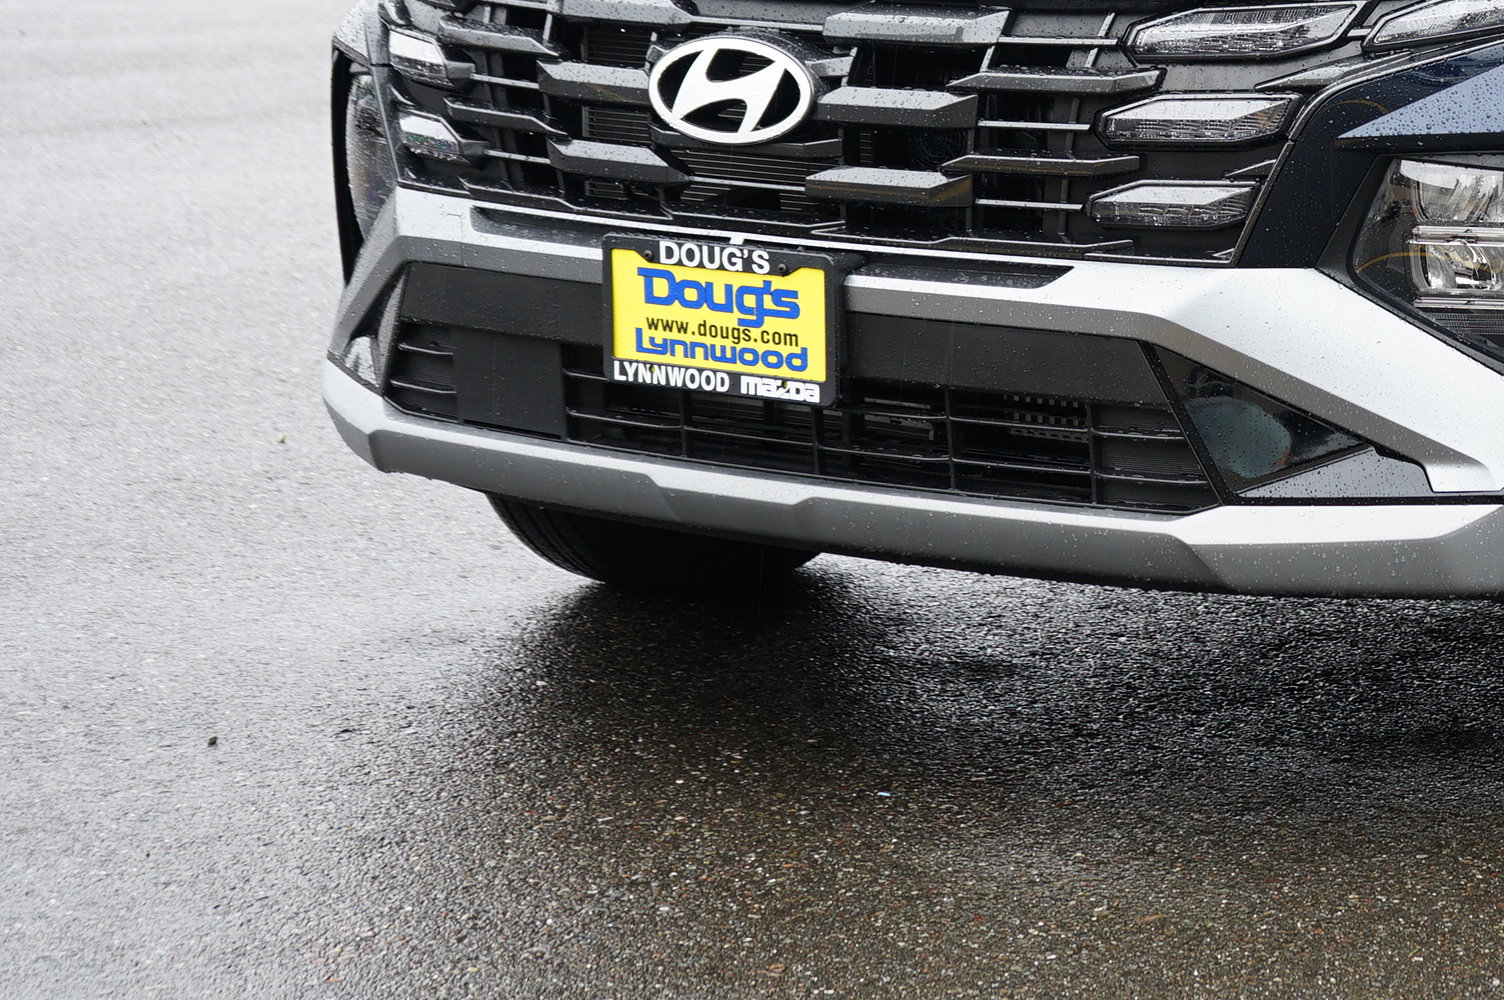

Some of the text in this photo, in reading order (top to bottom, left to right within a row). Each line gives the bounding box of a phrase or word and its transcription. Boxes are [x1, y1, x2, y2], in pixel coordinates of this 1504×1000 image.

[659, 240, 770, 275] DOUG'S
[637, 267, 800, 328] Doug's
[646, 316, 799, 347] www.dougs.com
[635, 328, 808, 372] Lynnwood
[613, 360, 730, 393] LYNNWOOD
